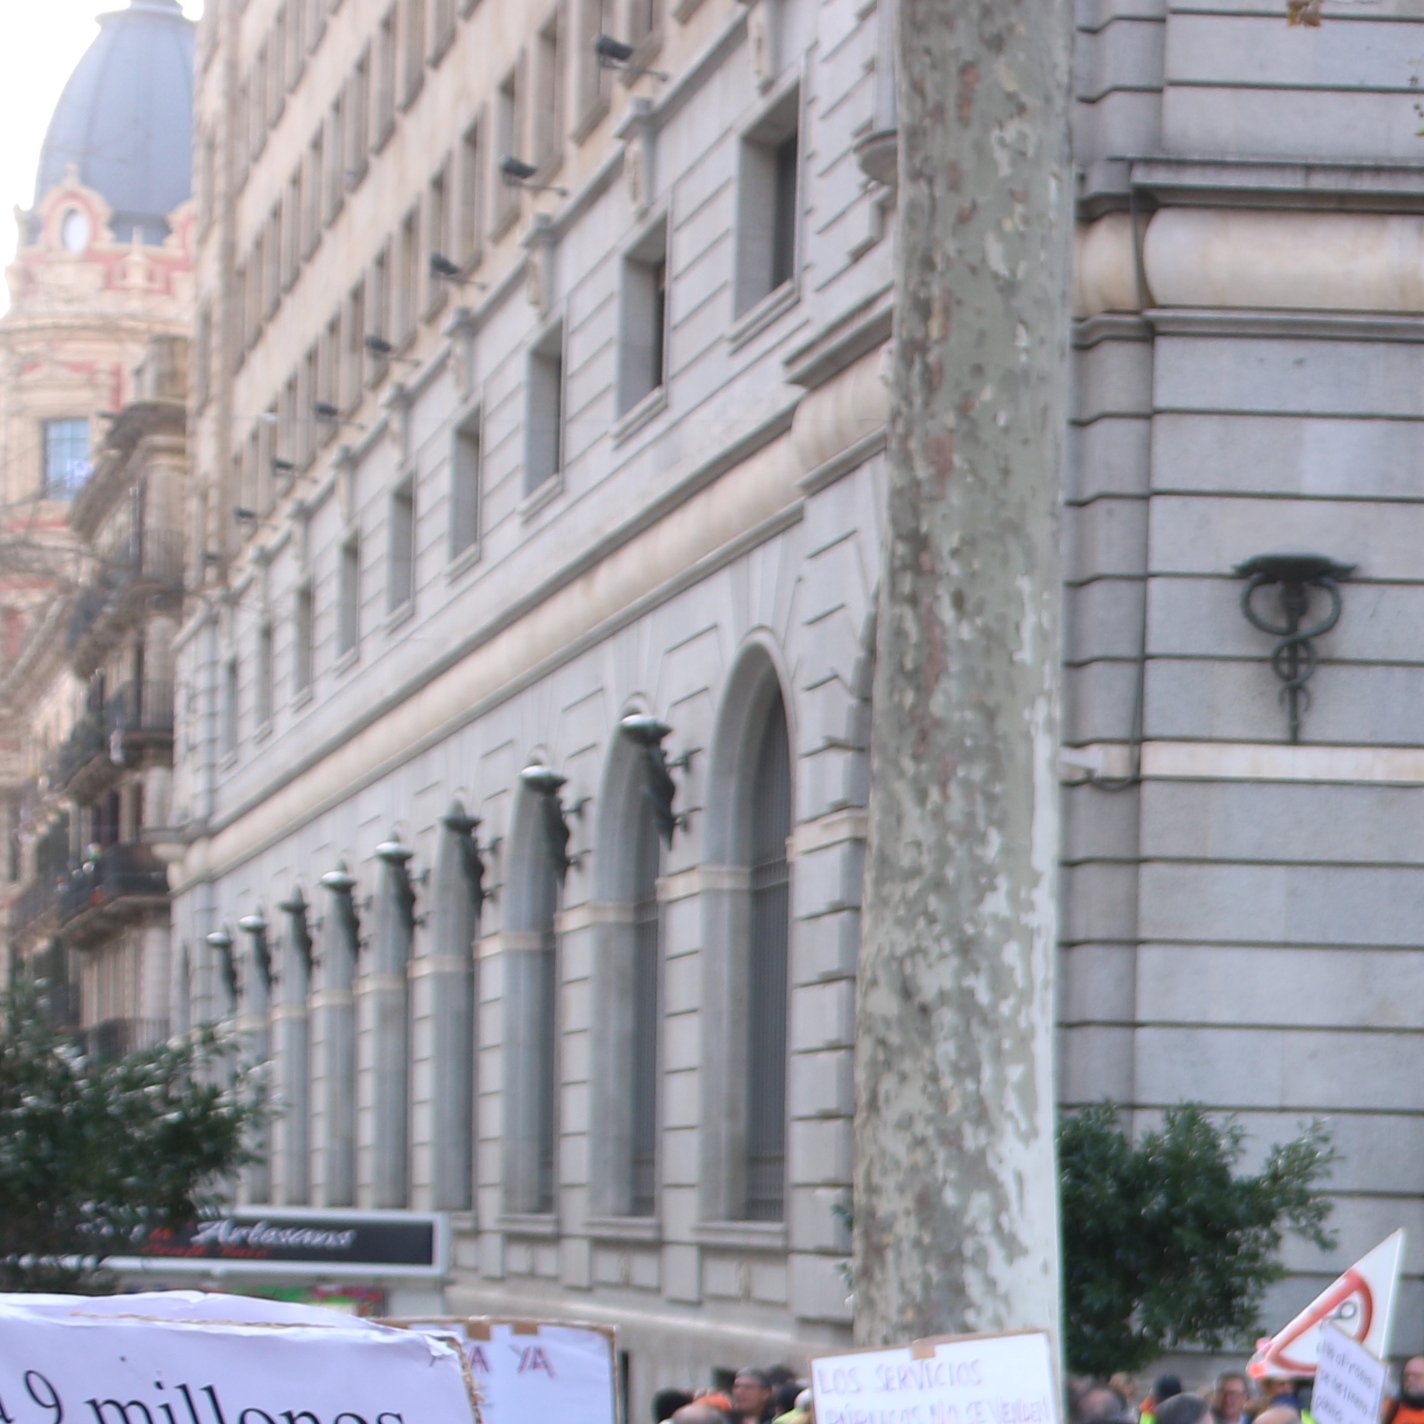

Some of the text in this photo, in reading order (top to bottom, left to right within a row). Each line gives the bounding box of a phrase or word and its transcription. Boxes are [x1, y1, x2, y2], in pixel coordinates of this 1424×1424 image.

[509, 1344, 557, 1380] YA
[817, 1358, 983, 1395] LOS SERVICIOS
